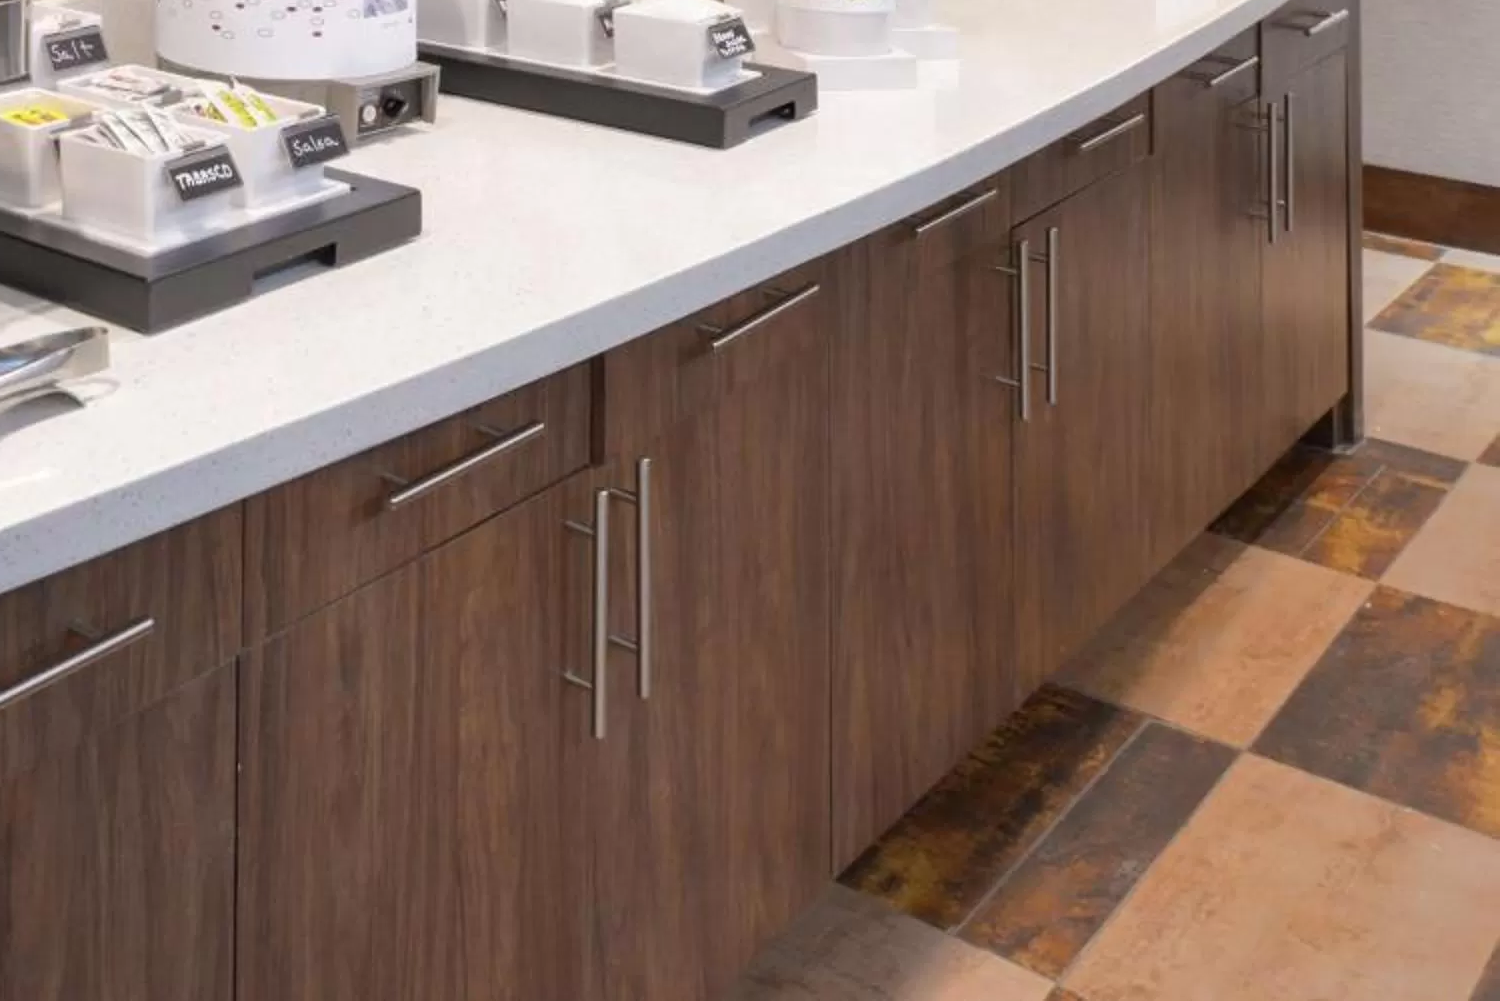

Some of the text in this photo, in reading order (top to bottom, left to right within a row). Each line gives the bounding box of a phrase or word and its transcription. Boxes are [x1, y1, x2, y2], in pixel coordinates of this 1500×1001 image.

[51, 41, 95, 63] Salt
[292, 132, 340, 158] Salsa
[174, 163, 234, 191] TABASCO
